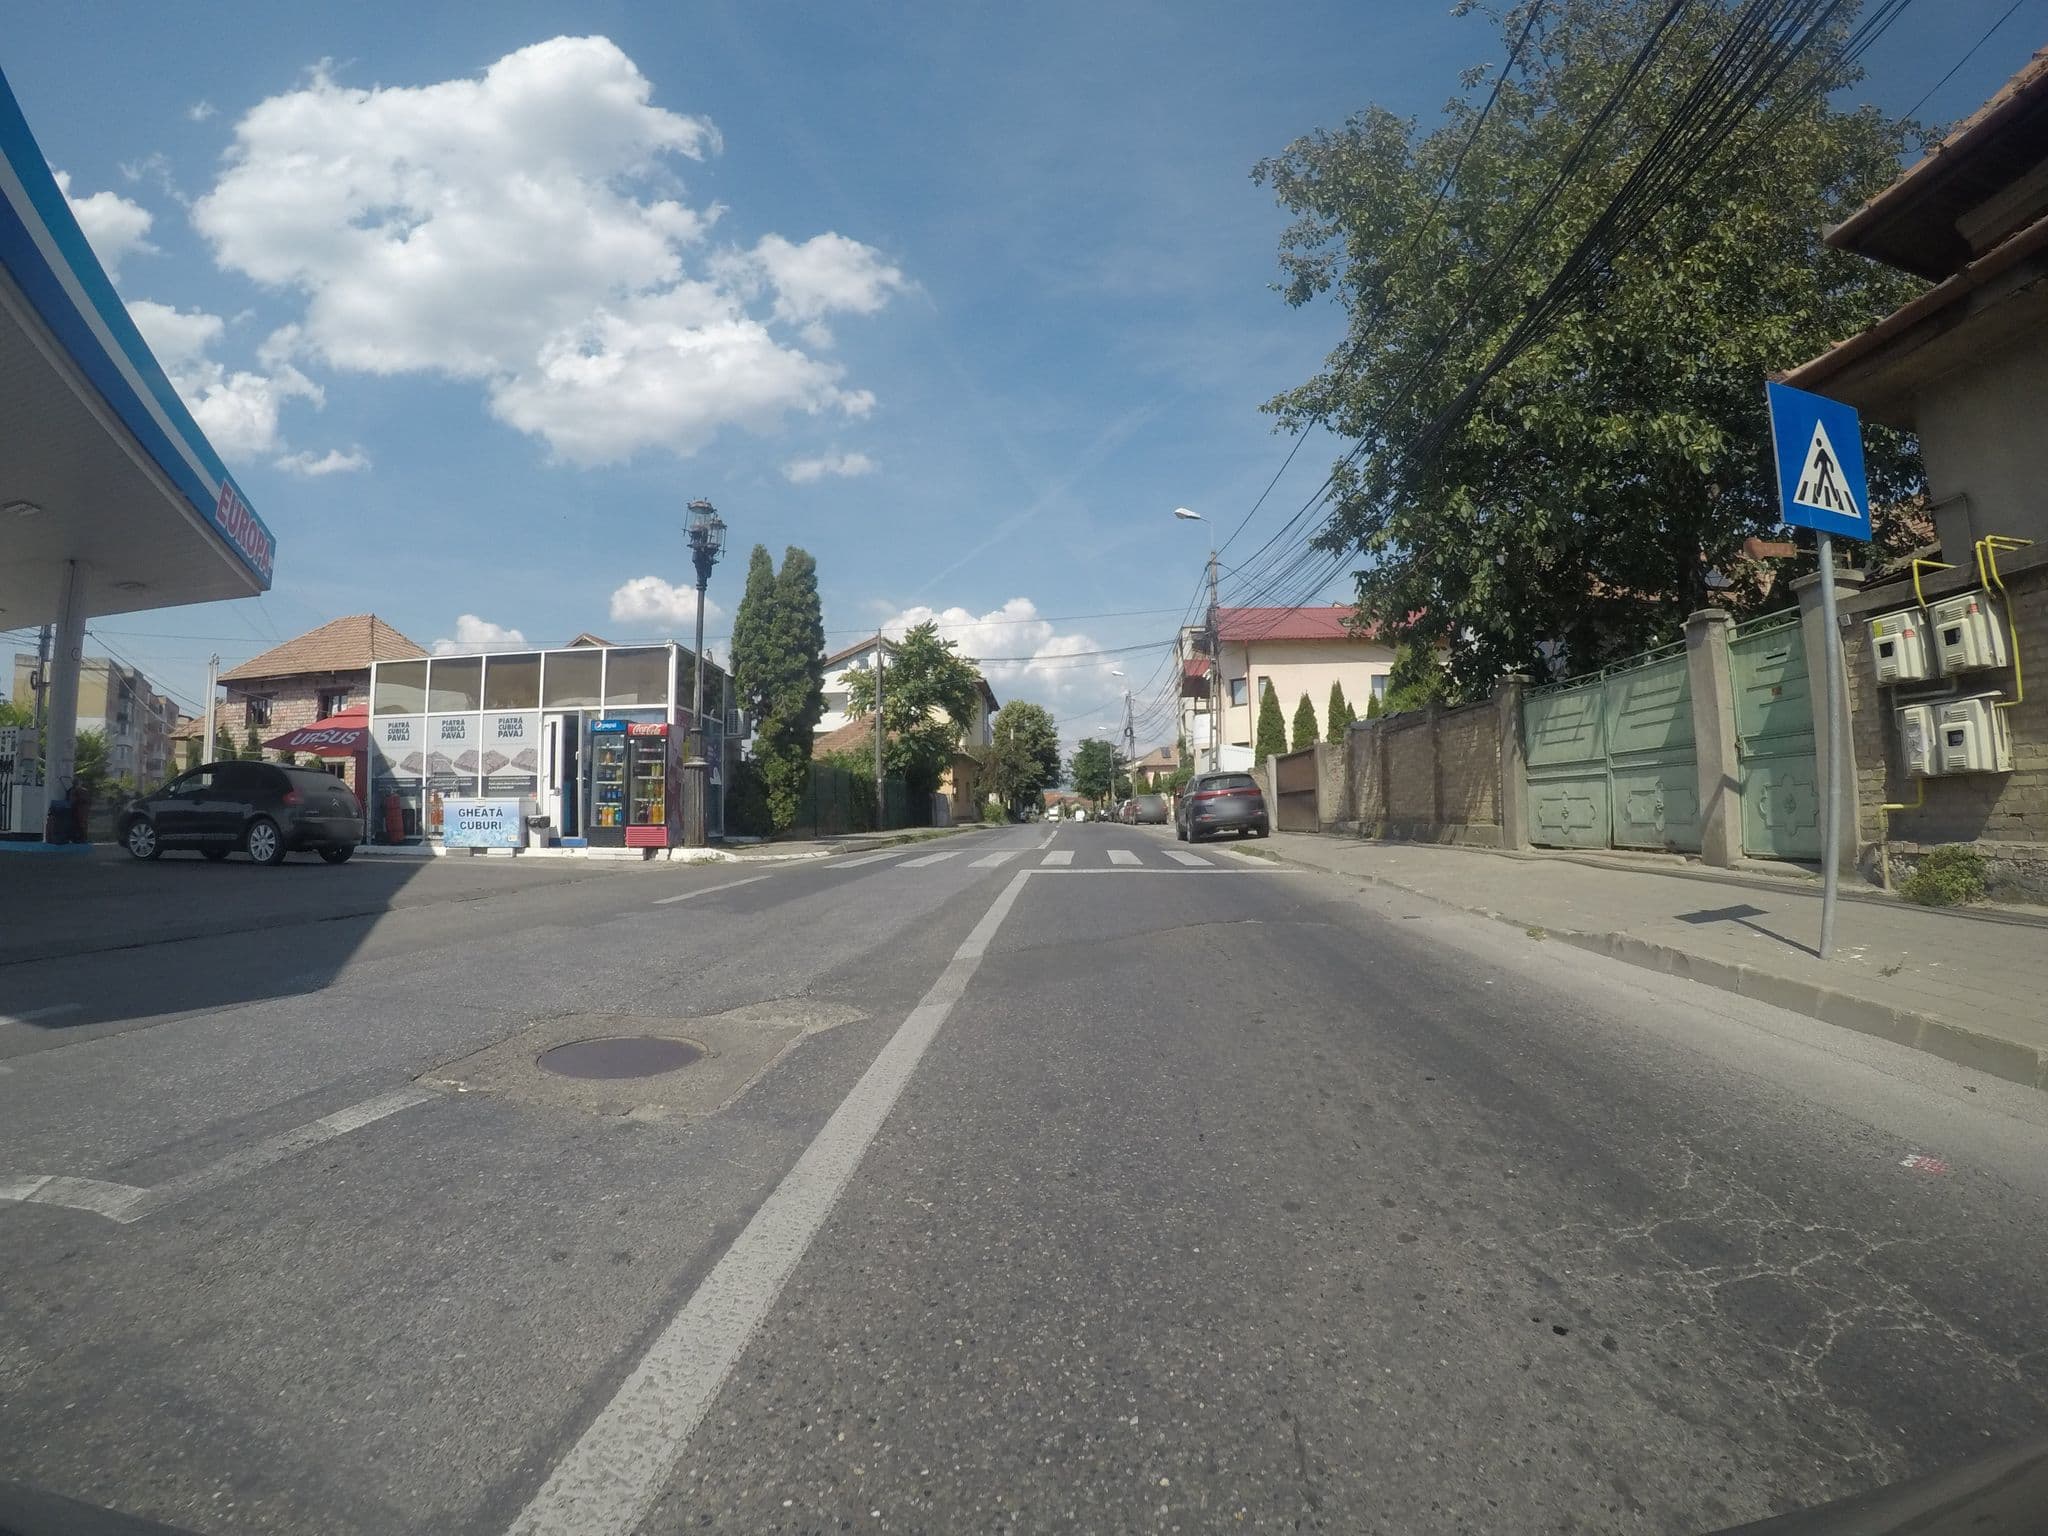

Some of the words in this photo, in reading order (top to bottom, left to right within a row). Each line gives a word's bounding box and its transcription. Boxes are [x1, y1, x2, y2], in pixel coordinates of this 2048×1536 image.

[215, 479, 273, 576] EUROPA
[290, 729, 360, 746] URSUS
[387, 734, 410, 742] PAVAJ
[441, 731, 465, 739] PAVAJ
[497, 730, 523, 738] PAVAJ
[459, 821, 502, 830] CUBURI
